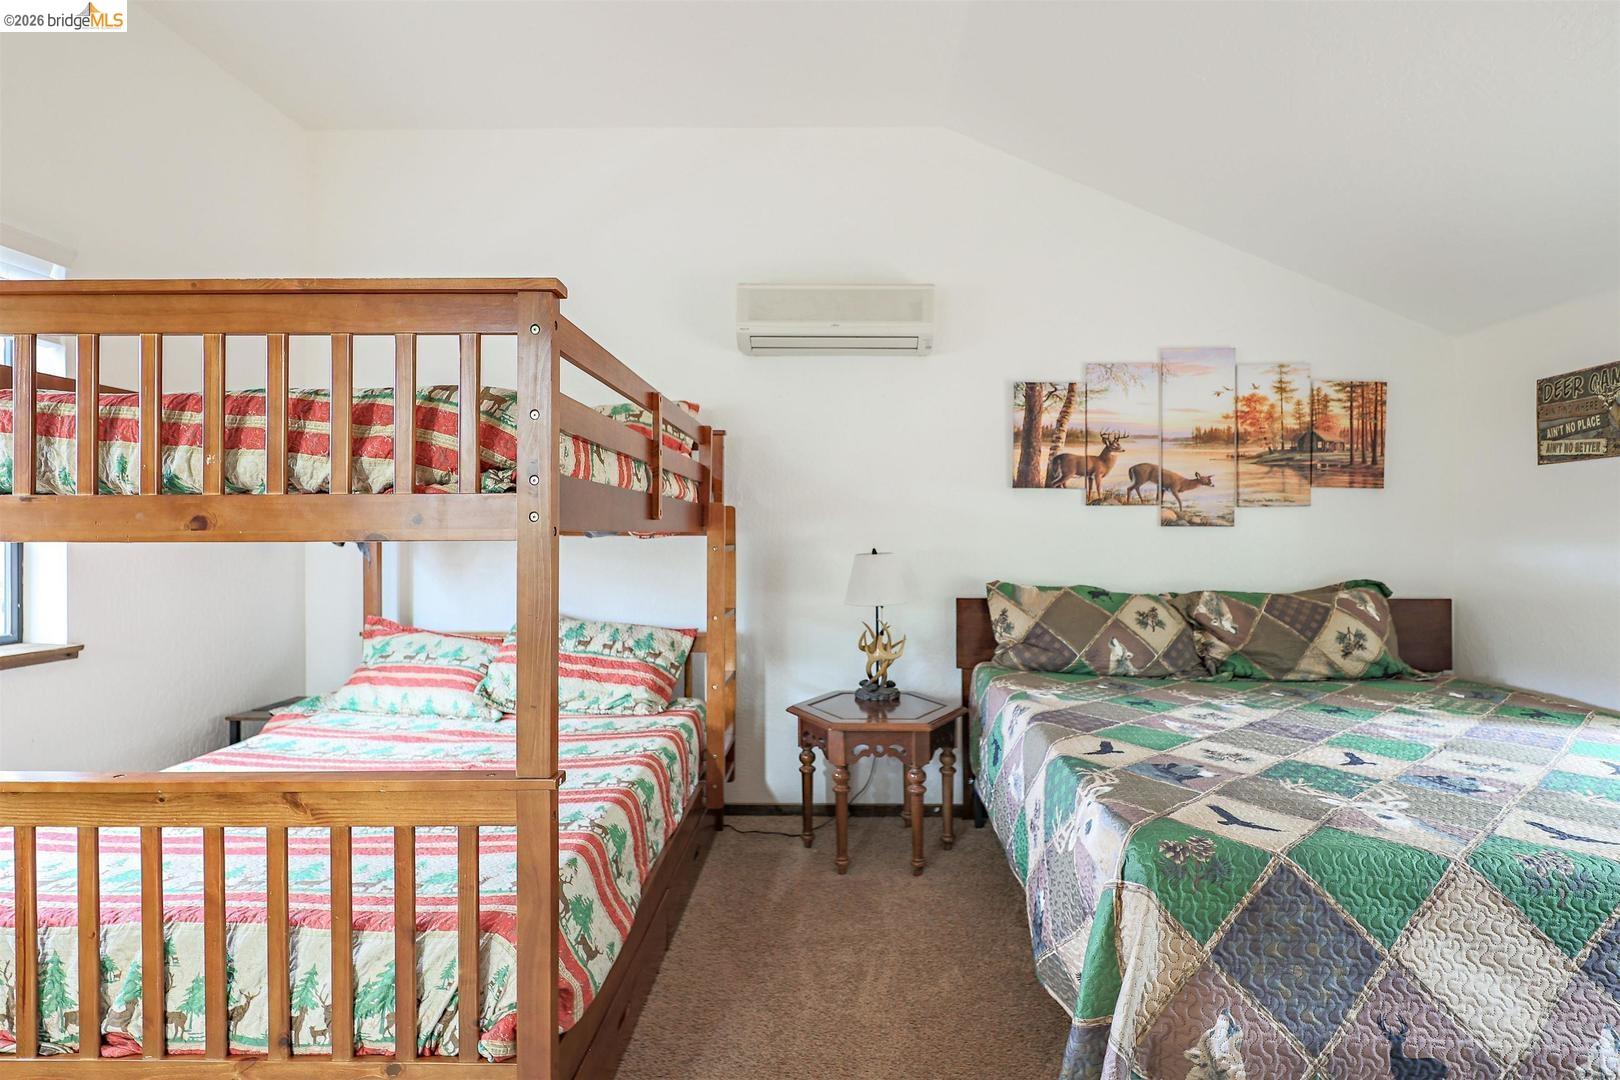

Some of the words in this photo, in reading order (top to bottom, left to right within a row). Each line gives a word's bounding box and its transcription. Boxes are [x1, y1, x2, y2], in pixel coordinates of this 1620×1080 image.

[1542, 375, 1584, 404] DEER
[1546, 424, 1564, 439] AIN'T
[1565, 421, 1576, 433] NO
[1577, 414, 1601, 431] PLACE
[1545, 442, 1563, 454] AIN'T
[1564, 442, 1573, 453] NO
[1574, 441, 1601, 453] BETTER
